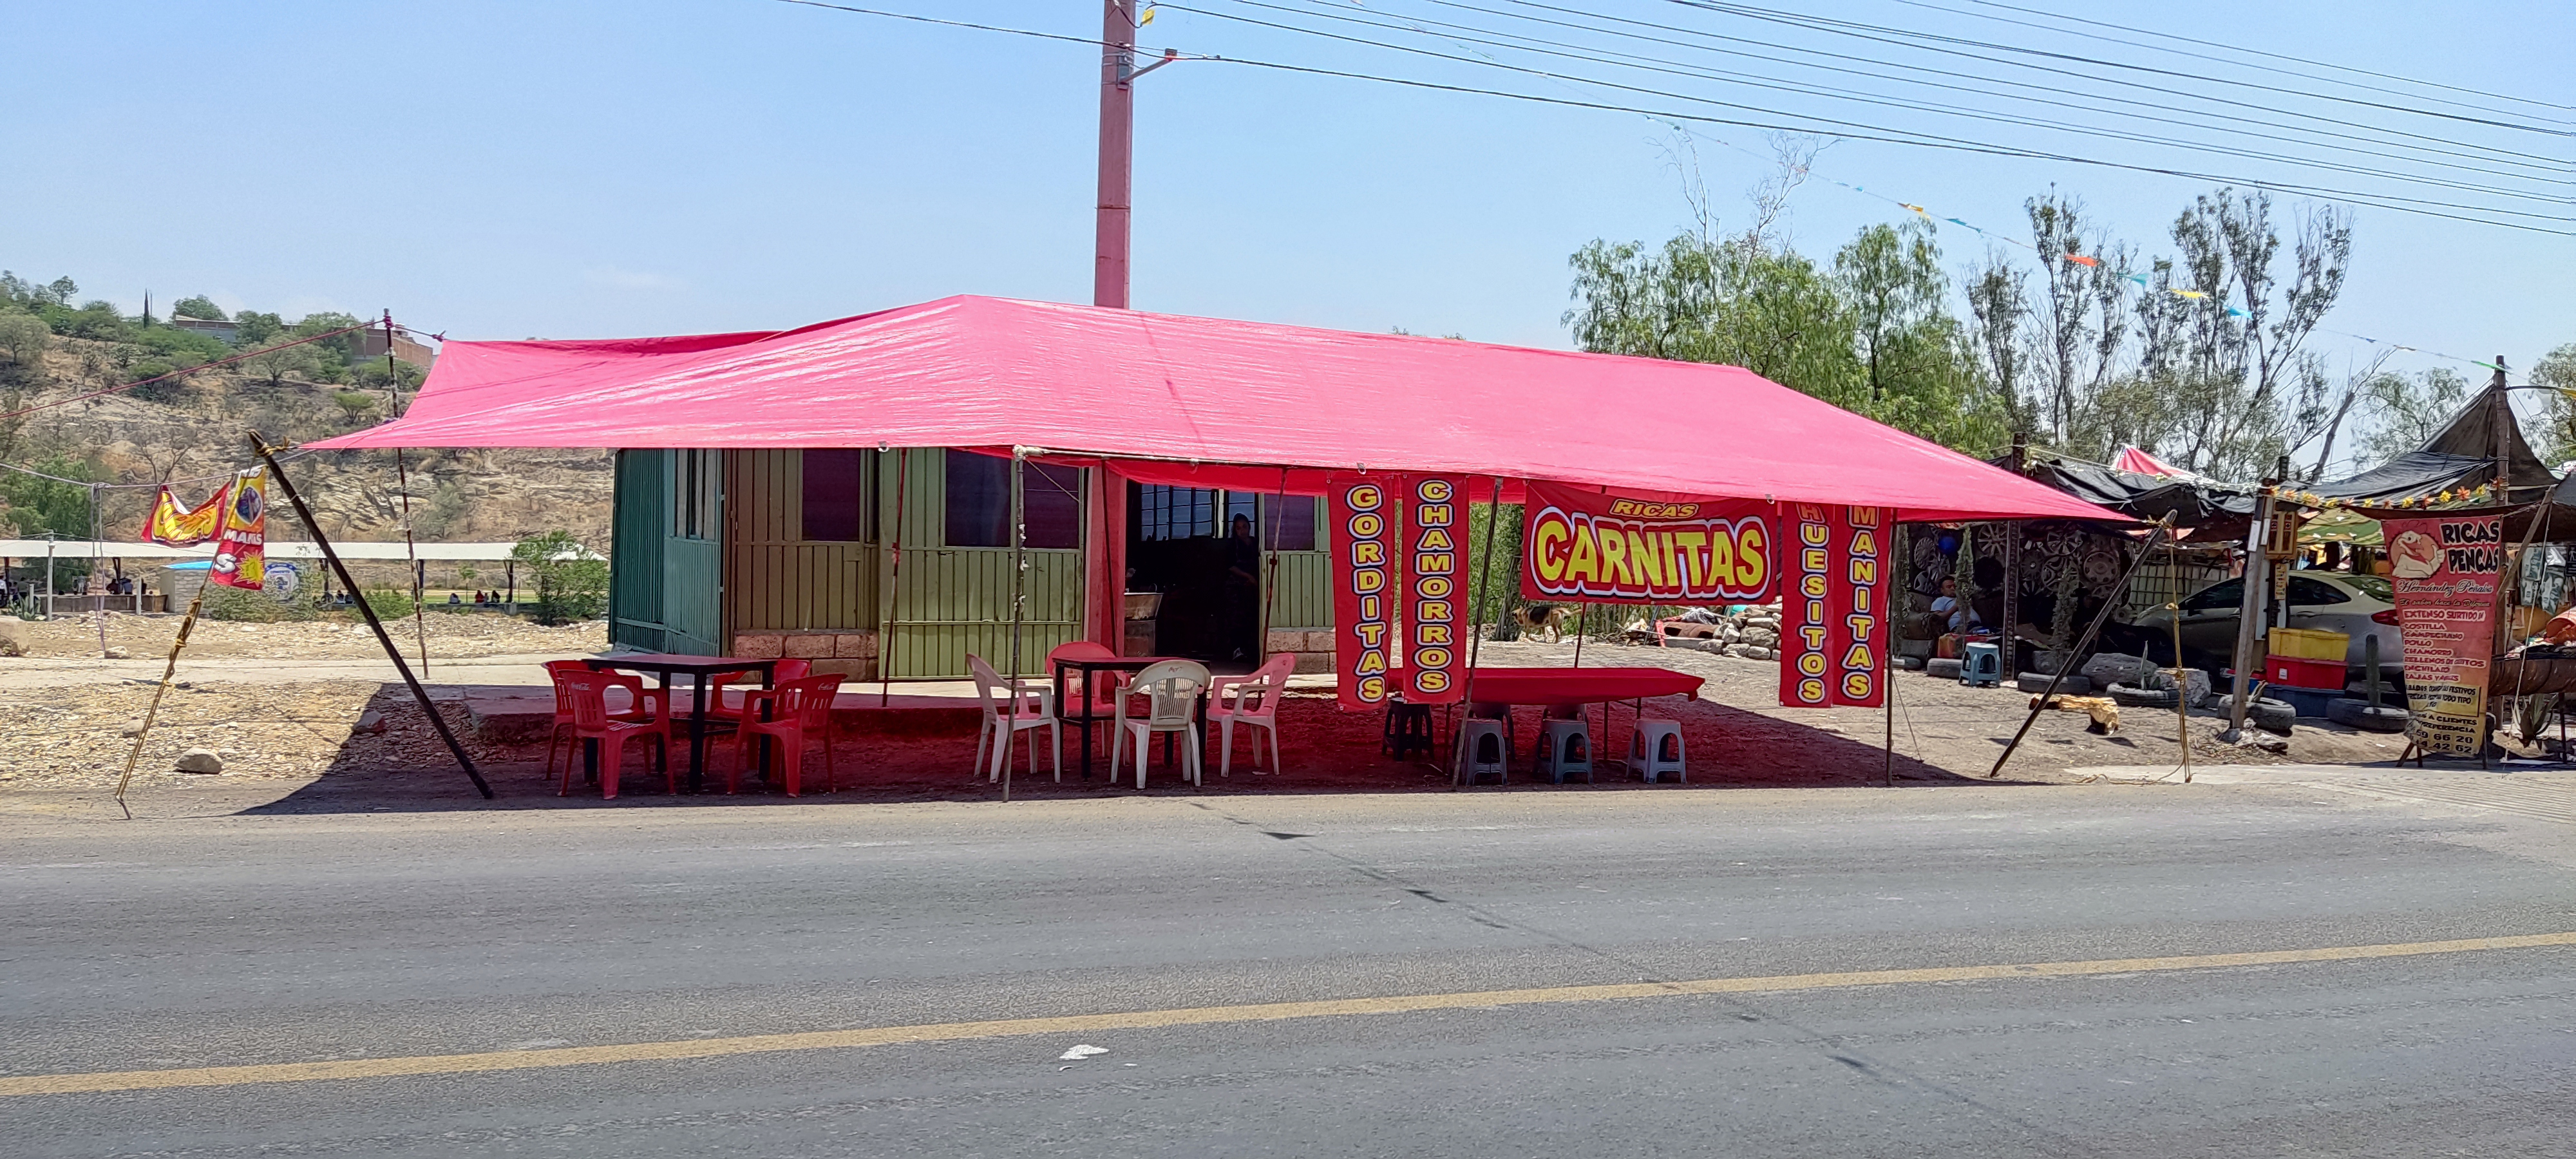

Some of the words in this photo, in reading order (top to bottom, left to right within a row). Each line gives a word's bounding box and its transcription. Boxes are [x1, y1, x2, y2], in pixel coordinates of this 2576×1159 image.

[1612, 500, 1698, 518] RICAS
[2440, 522, 2500, 544] RICAS
[1533, 513, 1767, 592] CARNITAS
[2447, 547, 2499, 572] PENCAS
[1349, 486, 1385, 701] GORDITAS
[1417, 482, 1453, 691] CHAMORROS
[2397, 580, 2455, 596] Hernández
[1798, 504, 1828, 702] HUESITOS
[1843, 506, 1878, 698] MANITAS
[2447, 611, 2477, 619] SURTIDO
[2448, 686, 2476, 695] FESTIVOS
[2436, 716, 2477, 725] CLIENTES
[2432, 742, 2450, 750] 42
[2456, 745, 2472, 754] 62
[2456, 735, 2473, 744] 20
